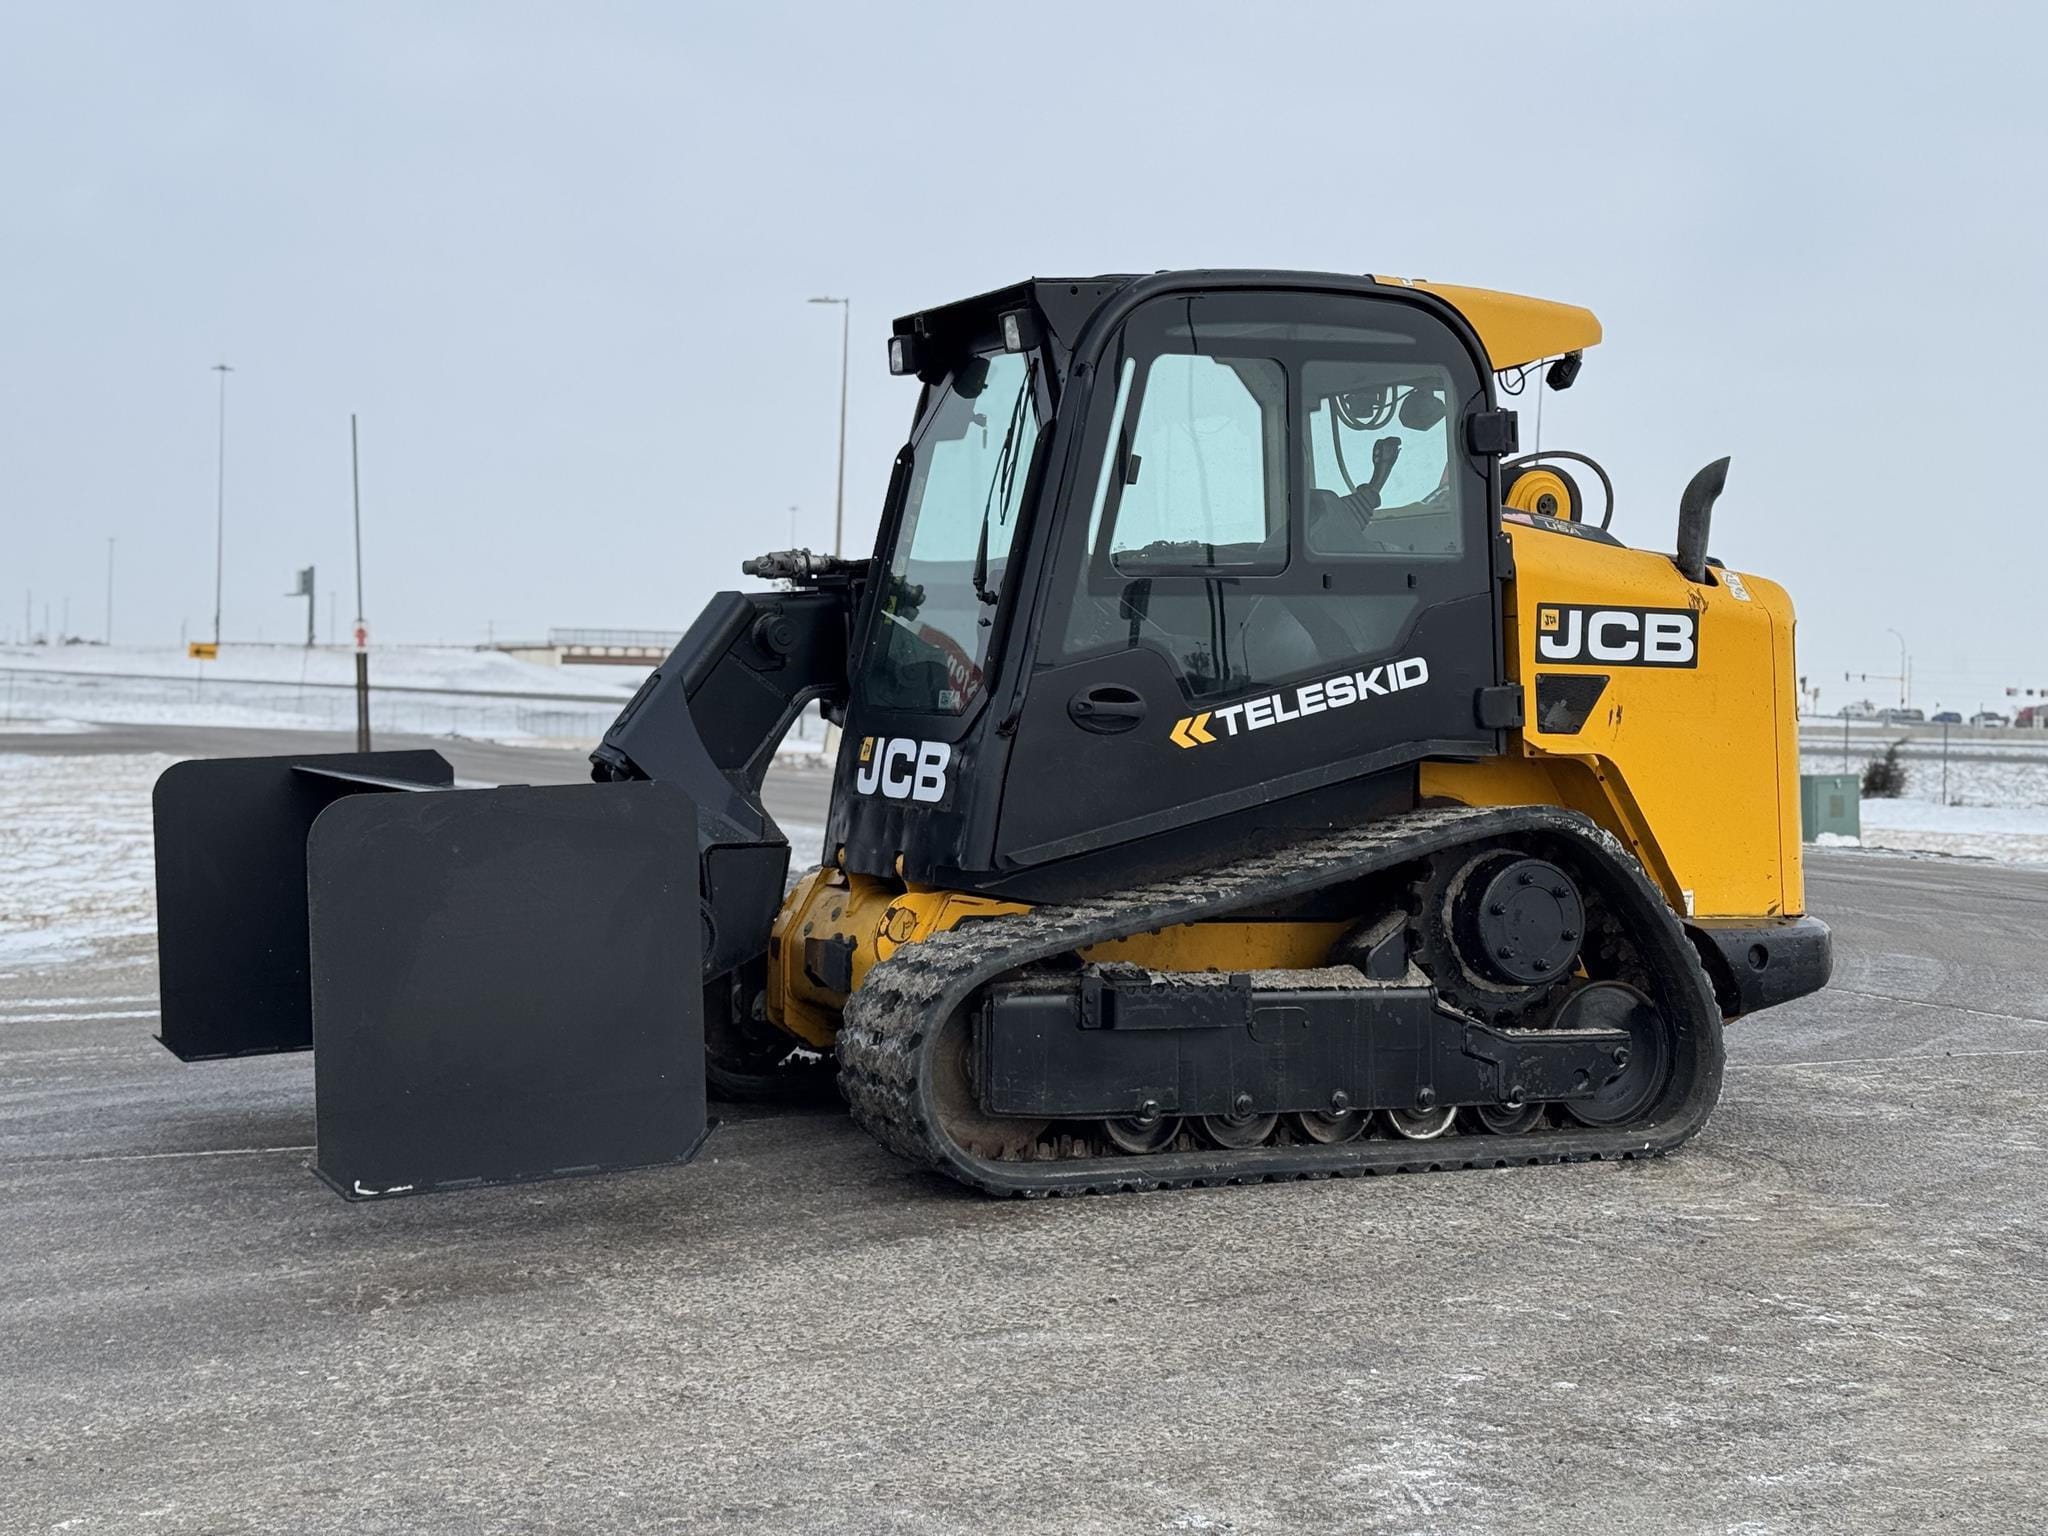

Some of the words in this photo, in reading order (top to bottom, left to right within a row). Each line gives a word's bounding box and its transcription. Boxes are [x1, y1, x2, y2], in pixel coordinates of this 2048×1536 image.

[1544, 520, 1582, 536] USA
[1539, 609, 1695, 663] JCB
[1214, 656, 1429, 737] TELESKID
[856, 737, 951, 803] JCB
